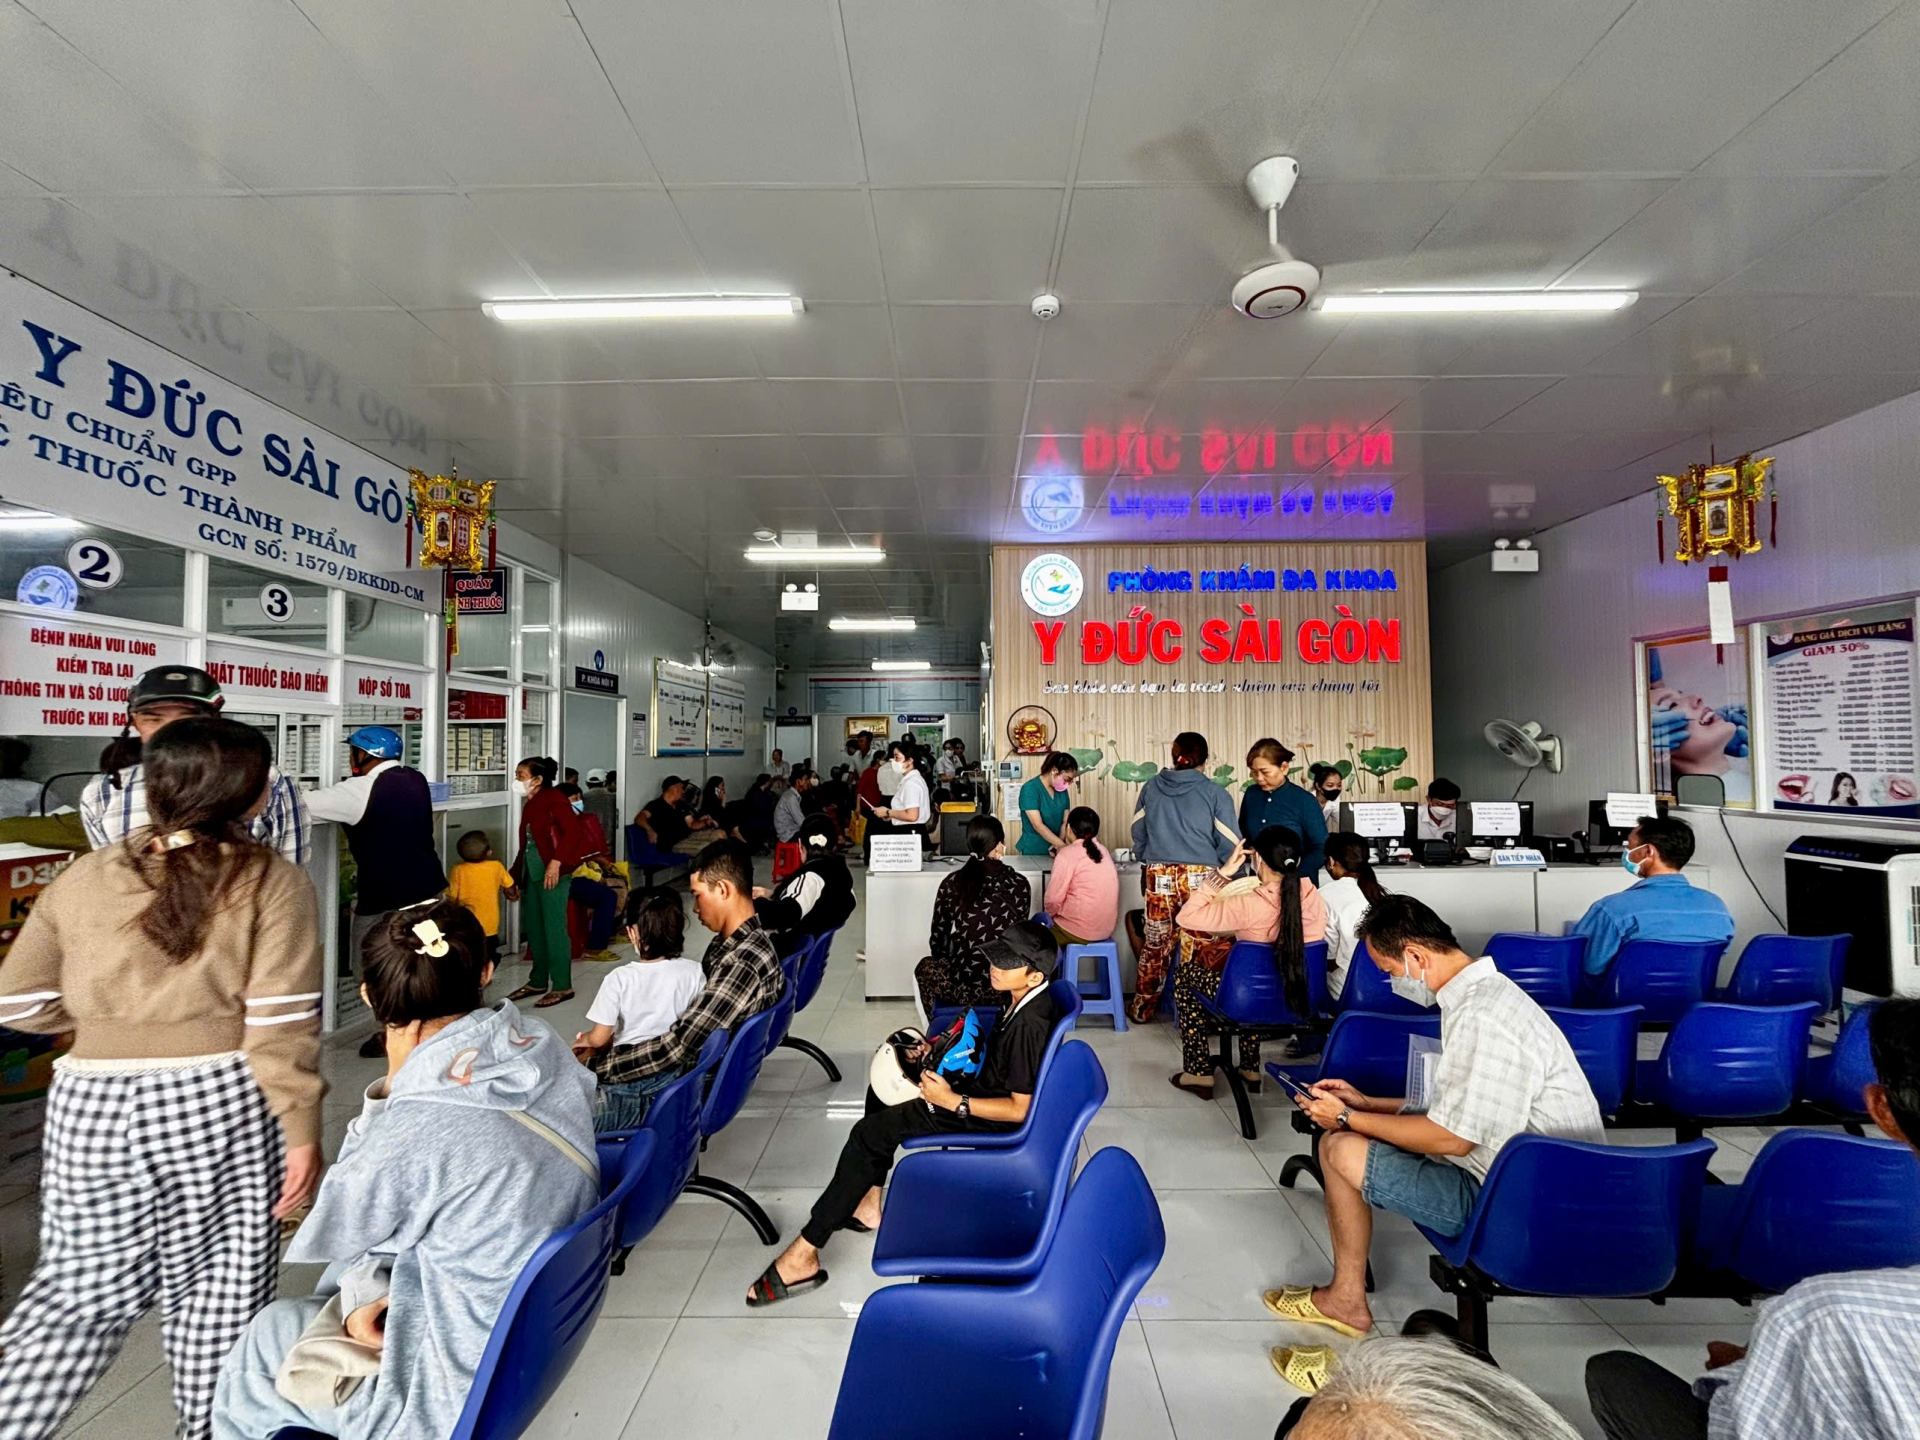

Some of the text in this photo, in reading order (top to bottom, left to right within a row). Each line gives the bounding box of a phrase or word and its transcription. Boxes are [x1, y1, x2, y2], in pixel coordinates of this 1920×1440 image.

[22, 319, 82, 388] Y
[105, 358, 243, 456] ĐỨC
[263, 433, 340, 500] SÀI
[0, 382, 237, 486] ÊU CHUẨN GPP
[28, 434, 357, 559] THUỐC THÀNH PHẨM
[198, 523, 247, 550] GCN
[254, 538, 288, 562] SỐ:
[79, 546, 110, 582] 2
[1108, 562, 1398, 593] PHÒNG KHÁM ĐA KHOA
[266, 588, 288, 617] 3
[472, 591, 503, 609] THUỐC
[31, 626, 156, 656] BỆNH NHÂN VUI LÒNG
[1031, 603, 1401, 665] Y ĐỨC SÀI GÒN
[1819, 630, 1835, 640] GIÁ
[1838, 627, 1861, 639] DỊCH
[1863, 624, 1877, 636] VỤ
[91, 660, 113, 676] TRA
[117, 663, 133, 680] LẠI
[238, 662, 277, 688] THUỐC
[280, 667, 301, 691] BẢO
[305, 668, 328, 693] HIỂM
[0, 678, 41, 697] THÔNG
[45, 683, 65, 698] TIN
[69, 683, 85, 699] VÀ
[107, 687, 131, 704] LƯỢ
[358, 676, 377, 698] NỘP
[395, 682, 411, 699] TOA
[88, 711, 108, 726] KHI
[112, 712, 127, 726] RA
